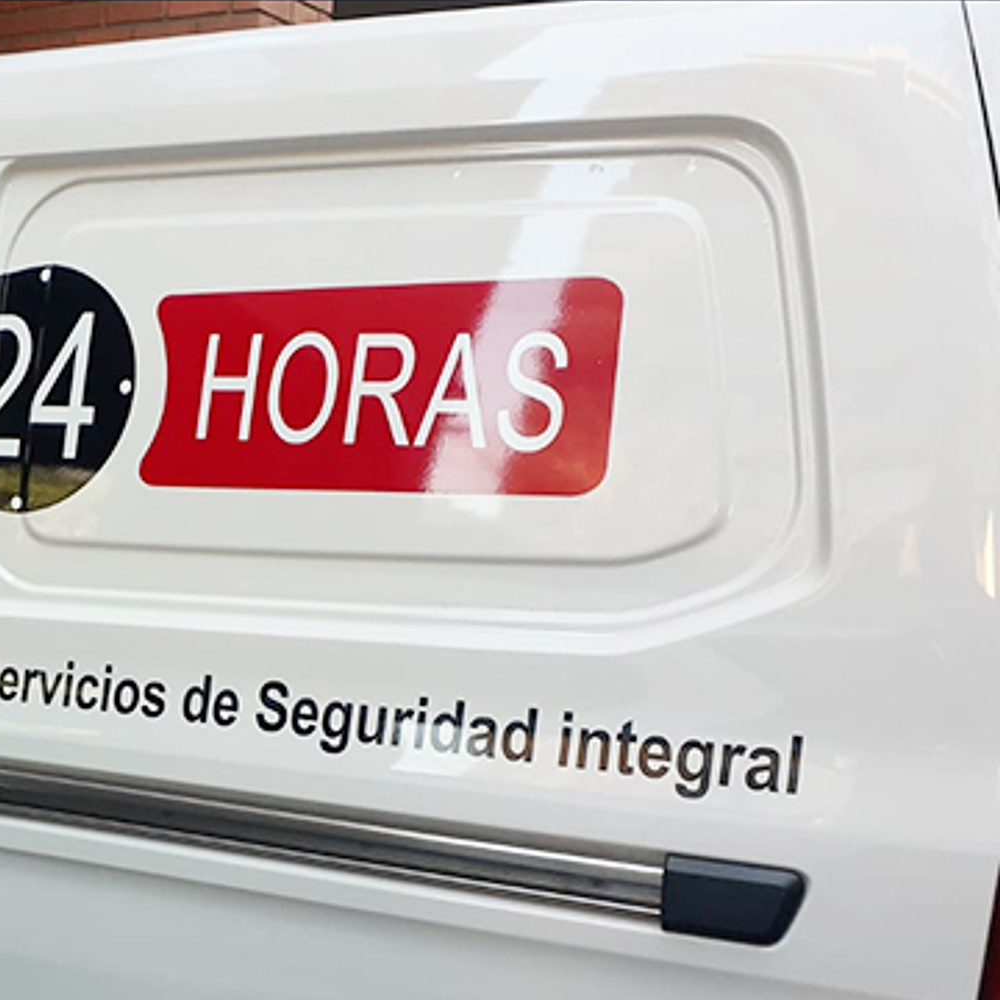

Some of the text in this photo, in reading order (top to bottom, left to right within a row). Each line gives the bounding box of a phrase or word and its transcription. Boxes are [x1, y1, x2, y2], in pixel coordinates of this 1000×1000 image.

[194, 330, 570, 453] HORAS
[181, 674, 240, 727] de
[254, 680, 538, 764] Seguridad
[557, 711, 805, 799] integral
